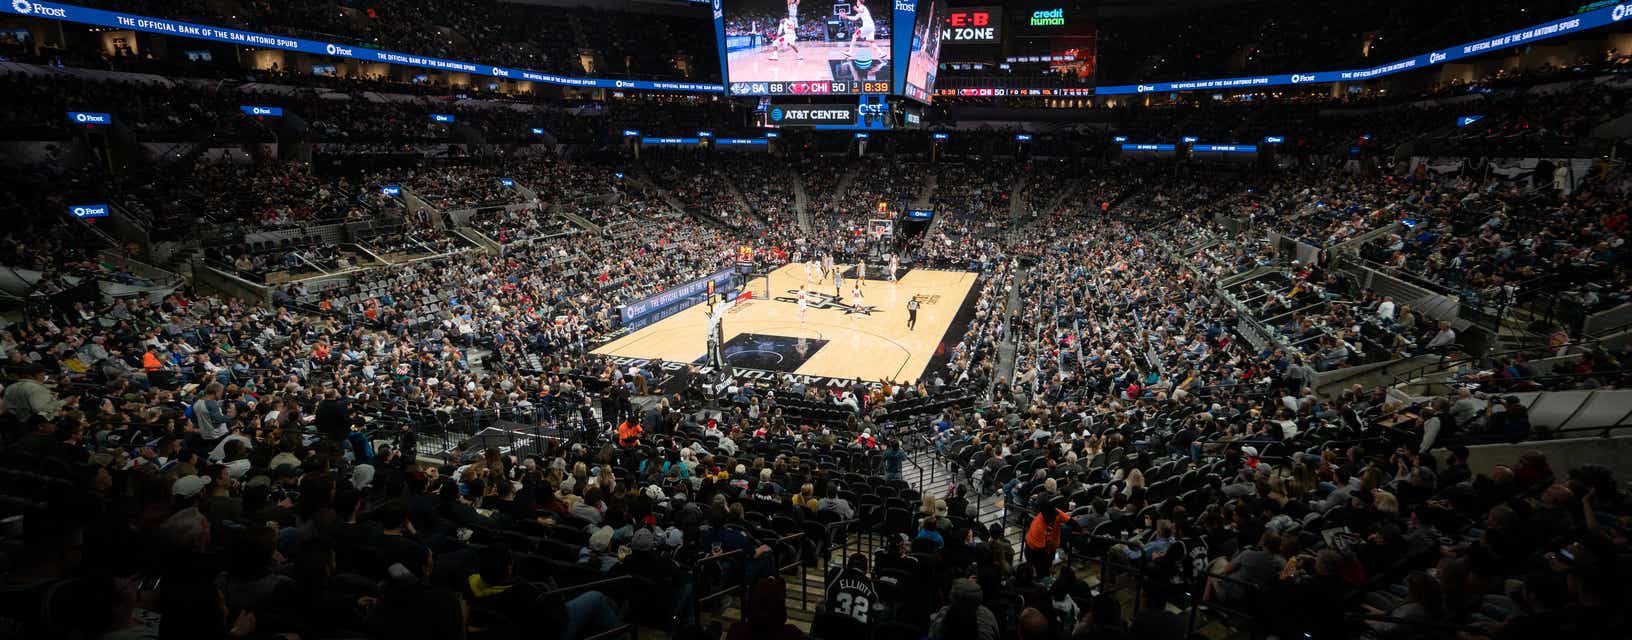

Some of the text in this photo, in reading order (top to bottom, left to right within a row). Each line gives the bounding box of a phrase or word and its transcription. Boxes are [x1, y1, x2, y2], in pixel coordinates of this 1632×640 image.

[34, 3, 67, 17] Frost
[896, 0, 915, 12] Frost
[1033, 8, 1063, 18] credit
[1030, 16, 1064, 26] human
[117, 16, 298, 48] THE OFFICIAL BANK OF THE SAN ANTONIO SPURS
[942, 28, 994, 40] N ZONE
[1464, 46, 1472, 54] THE
[1472, 42, 1490, 52] OFFICIAL
[1492, 39, 1504, 47] BANK
[1512, 33, 1521, 41] THE
[1522, 31, 1533, 39] SAN
[1534, 25, 1557, 36] ANTONIO
[1559, 19, 1580, 31] SPURS
[378, 52, 387, 60] THE
[388, 54, 408, 62] OFFICIAL
[752, 83, 765, 92] SA
[770, 82, 783, 92] 68
[812, 82, 828, 92] CHI
[832, 82, 845, 92] 50
[865, 82, 888, 92] 8:39
[86, 114, 104, 123] Frost
[785, 110, 849, 120] AT&T CENTER
[85, 206, 105, 215] Frost
[840, 578, 872, 598] ELLIOTT
[834, 592, 870, 624] 32
